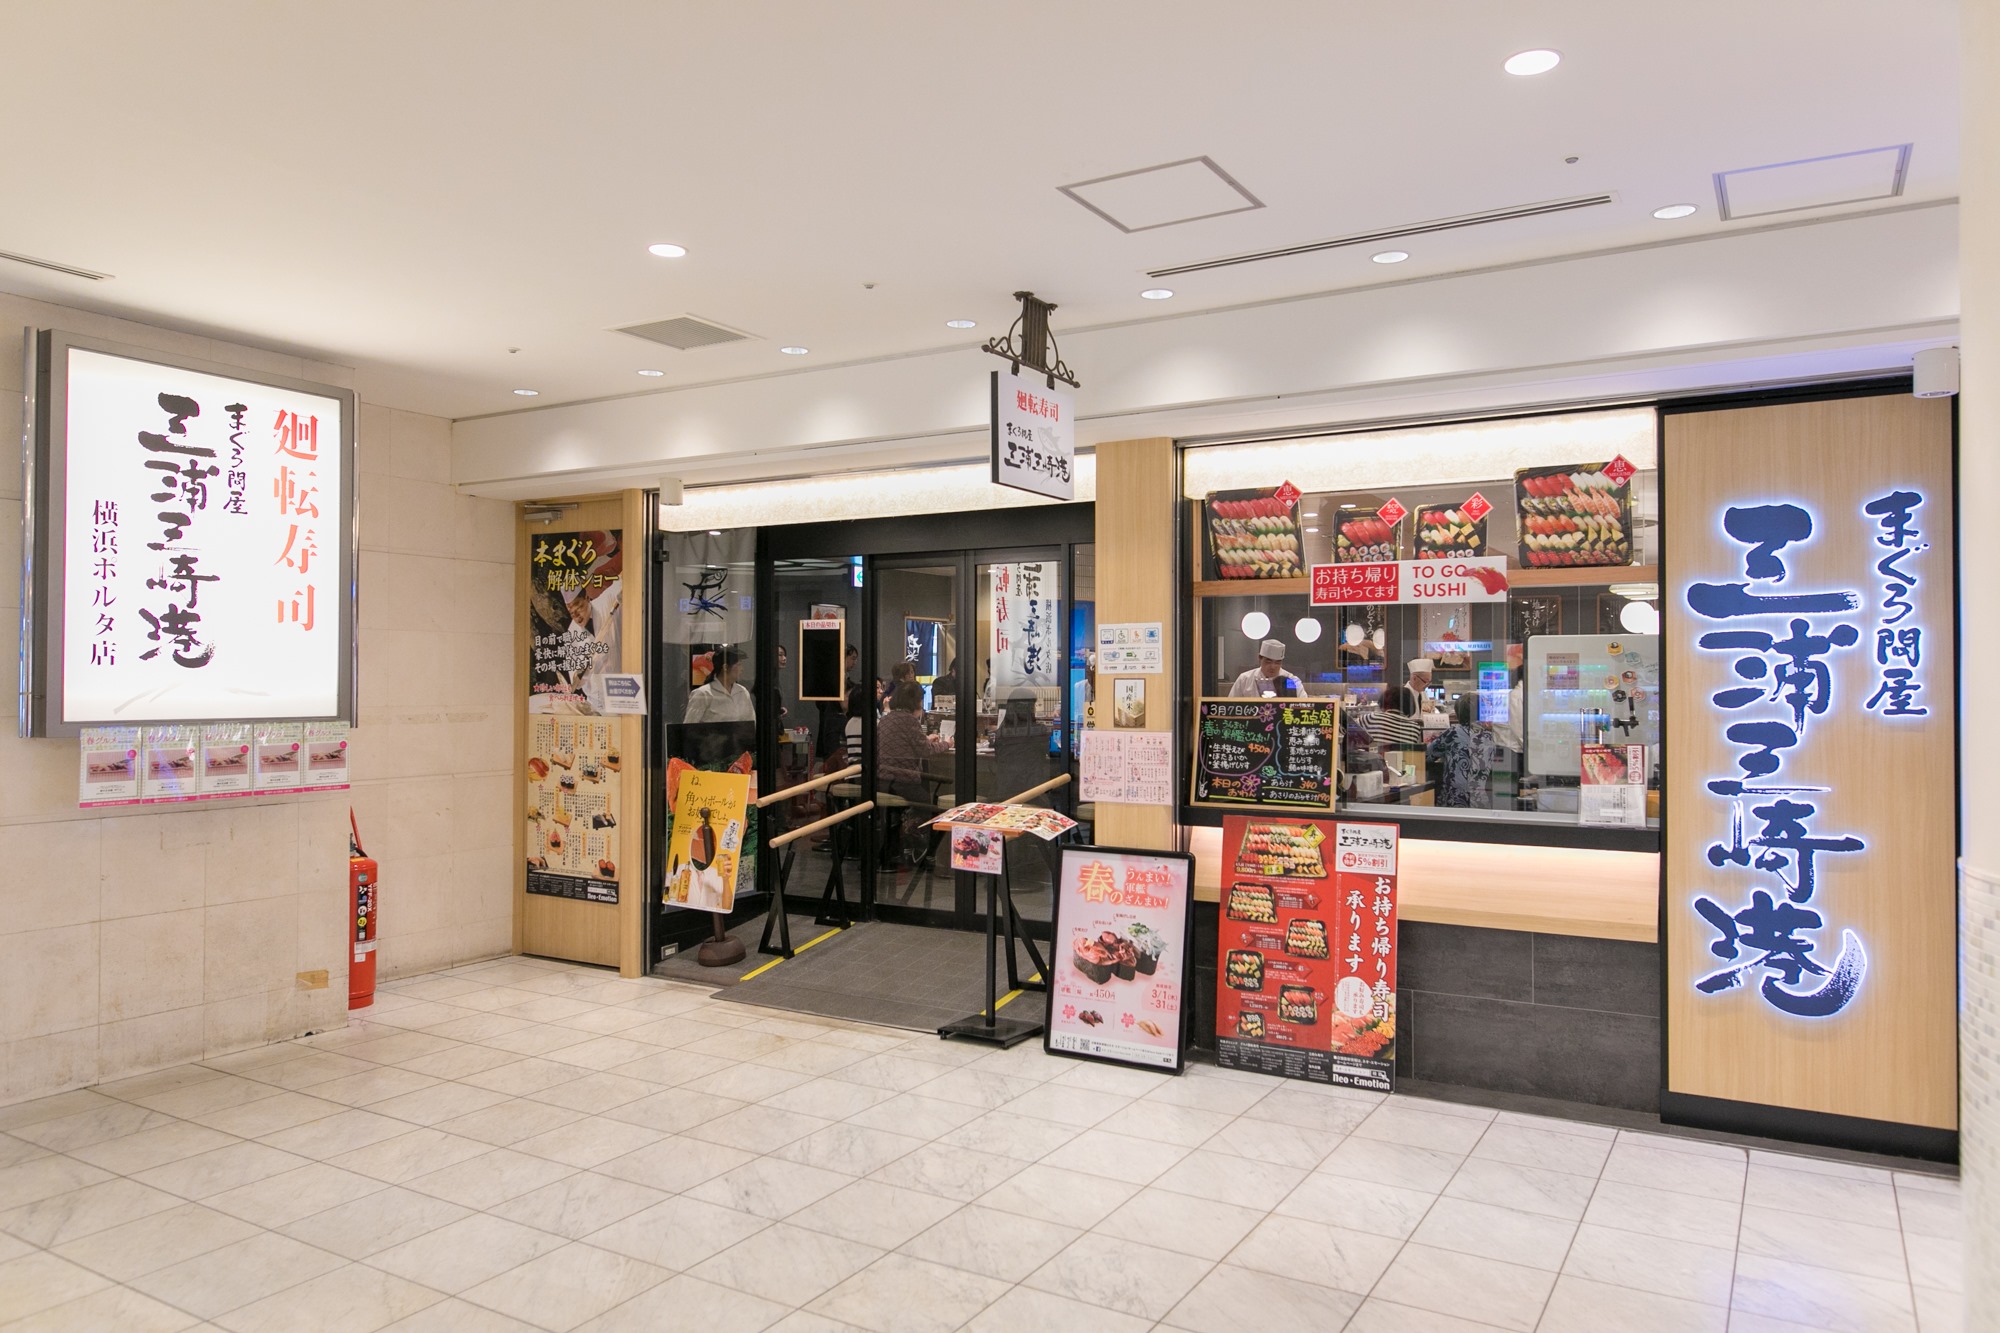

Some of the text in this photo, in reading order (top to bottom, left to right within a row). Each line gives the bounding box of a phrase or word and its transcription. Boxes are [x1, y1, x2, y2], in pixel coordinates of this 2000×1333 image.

[1016, 389, 1059, 422] 廻転寿司
[223, 402, 249, 515] まぐろ問屋
[1004, 441, 1071, 483] 三浦三崎港
[138, 391, 221, 669] 三浦三崎港
[273, 408, 319, 632] 廻転寿司
[534, 538, 597, 568] 本まぐろ
[1412, 564, 1467, 578] TO GO
[90, 499, 119, 667] 横浜ポルタ店
[546, 568, 620, 592] 解体ショー
[1315, 584, 1398, 600] 寿司やってます
[1316, 566, 1396, 586] お持ち帰り
[1413, 582, 1466, 598] SUSHI
[1865, 490, 1930, 717] まぐろ問屋
[1687, 503, 1868, 1018] 三浦三崎港
[1212, 777, 1240, 788] 本日の
[1078, 861, 1124, 904] 春の
[1127, 867, 1171, 885] うんまい!
[1124, 894, 1169, 909] ざんまい!
[1345, 889, 1367, 974] 承ります
[1371, 876, 1393, 1023] お持ち帰り寿司
